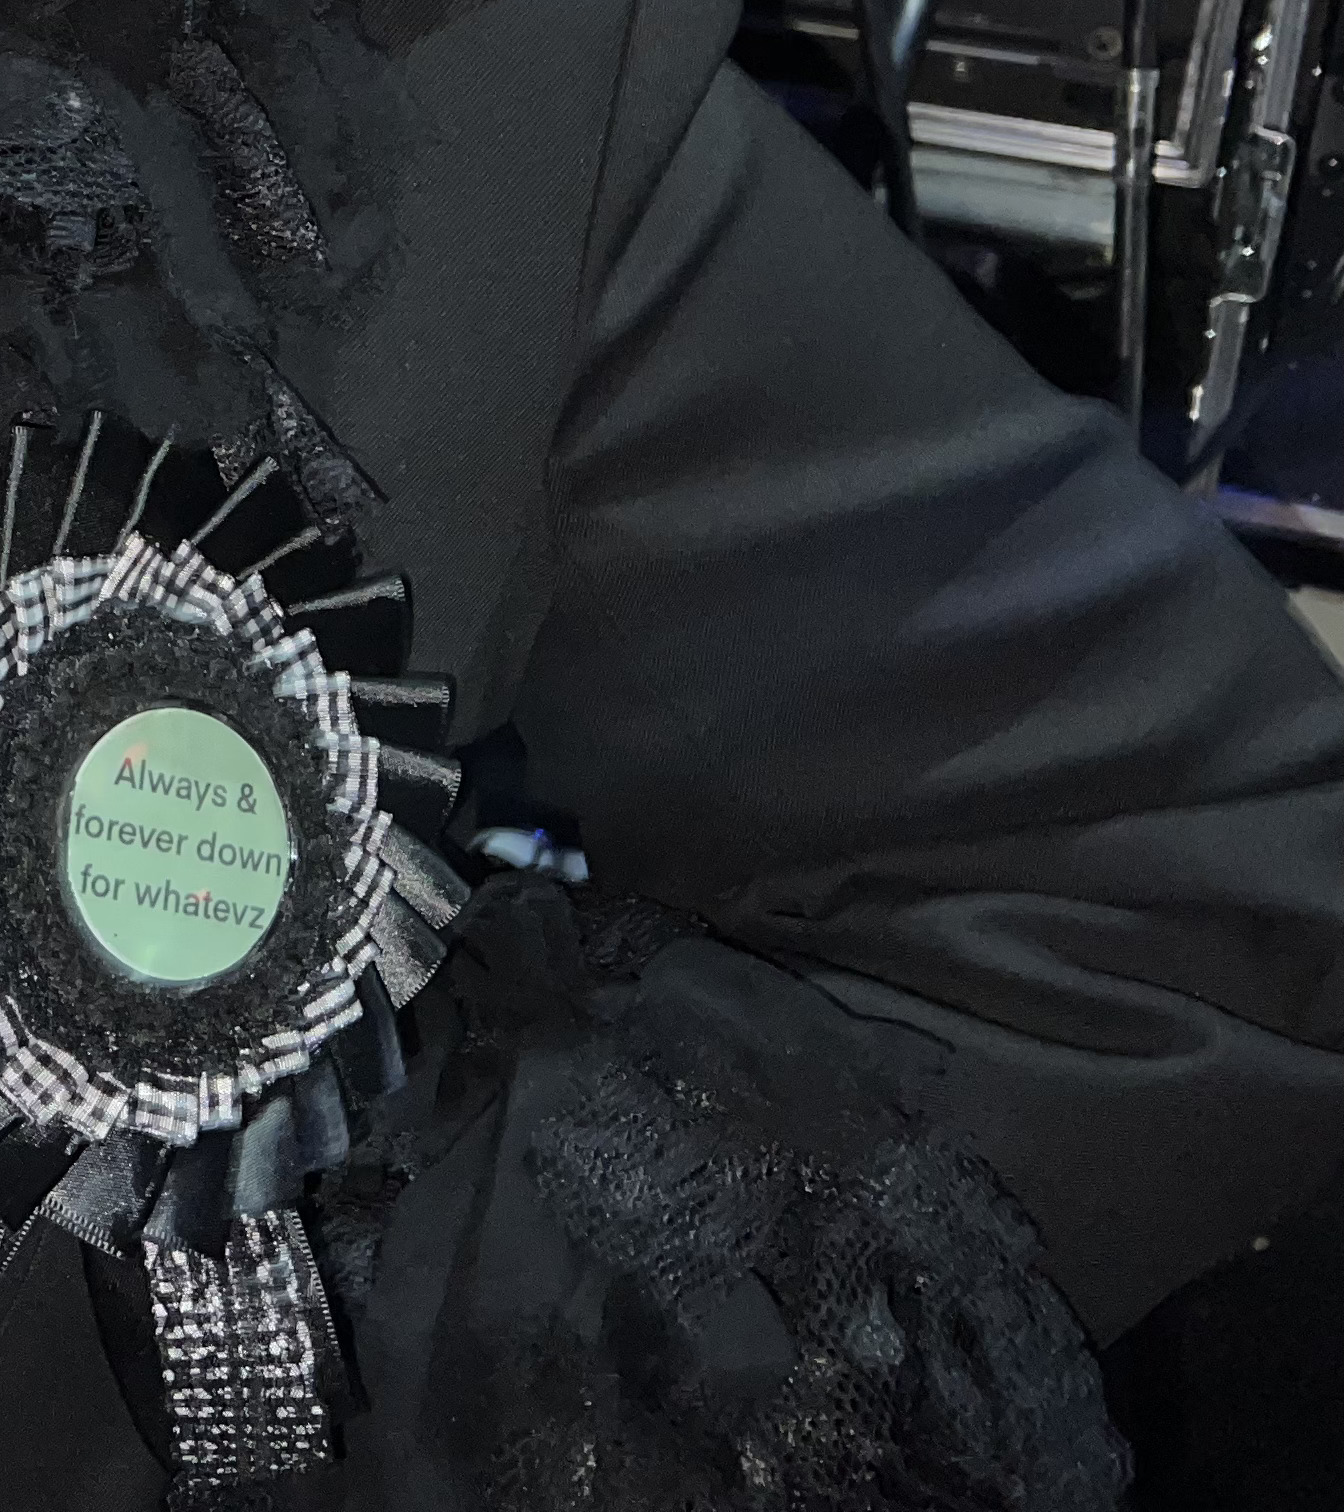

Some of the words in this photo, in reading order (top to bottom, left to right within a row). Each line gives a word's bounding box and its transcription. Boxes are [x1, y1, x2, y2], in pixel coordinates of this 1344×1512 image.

[113, 757, 228, 812] Always
[236, 782, 258, 815] &
[74, 804, 189, 857] forever
[196, 831, 283, 877] down
[79, 864, 126, 900] for
[134, 879, 266, 930] whatevz
